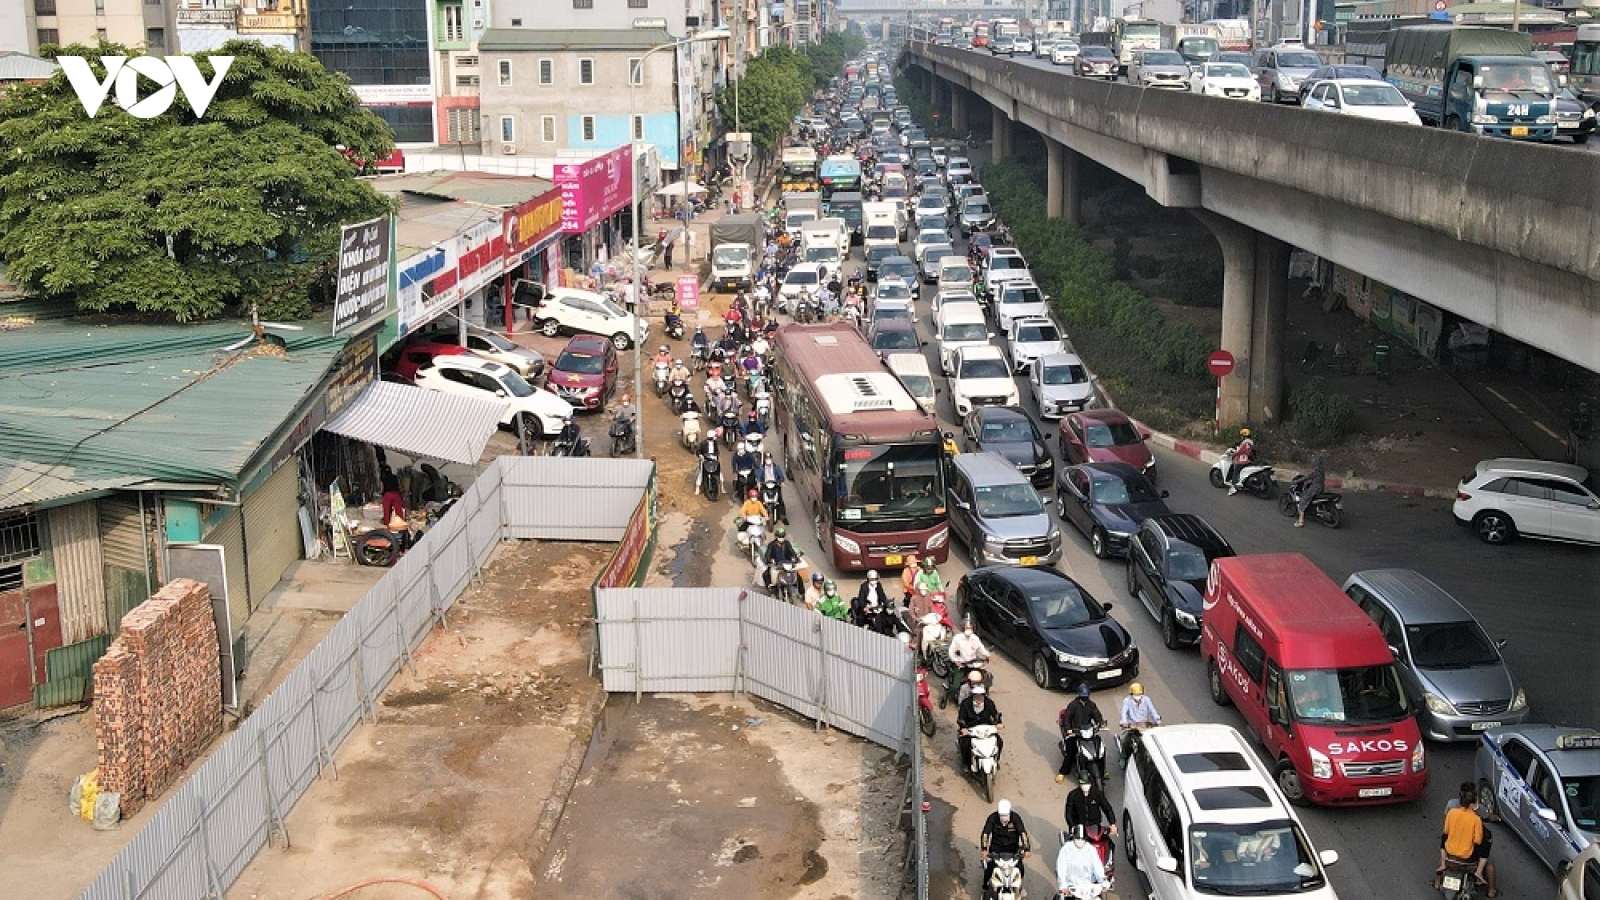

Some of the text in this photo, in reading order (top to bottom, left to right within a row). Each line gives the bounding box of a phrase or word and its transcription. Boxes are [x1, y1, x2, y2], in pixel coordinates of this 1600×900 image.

[1506, 103, 1529, 116] 24H
[561, 221, 579, 230] 254
[1327, 739, 1409, 755] SAKOS
